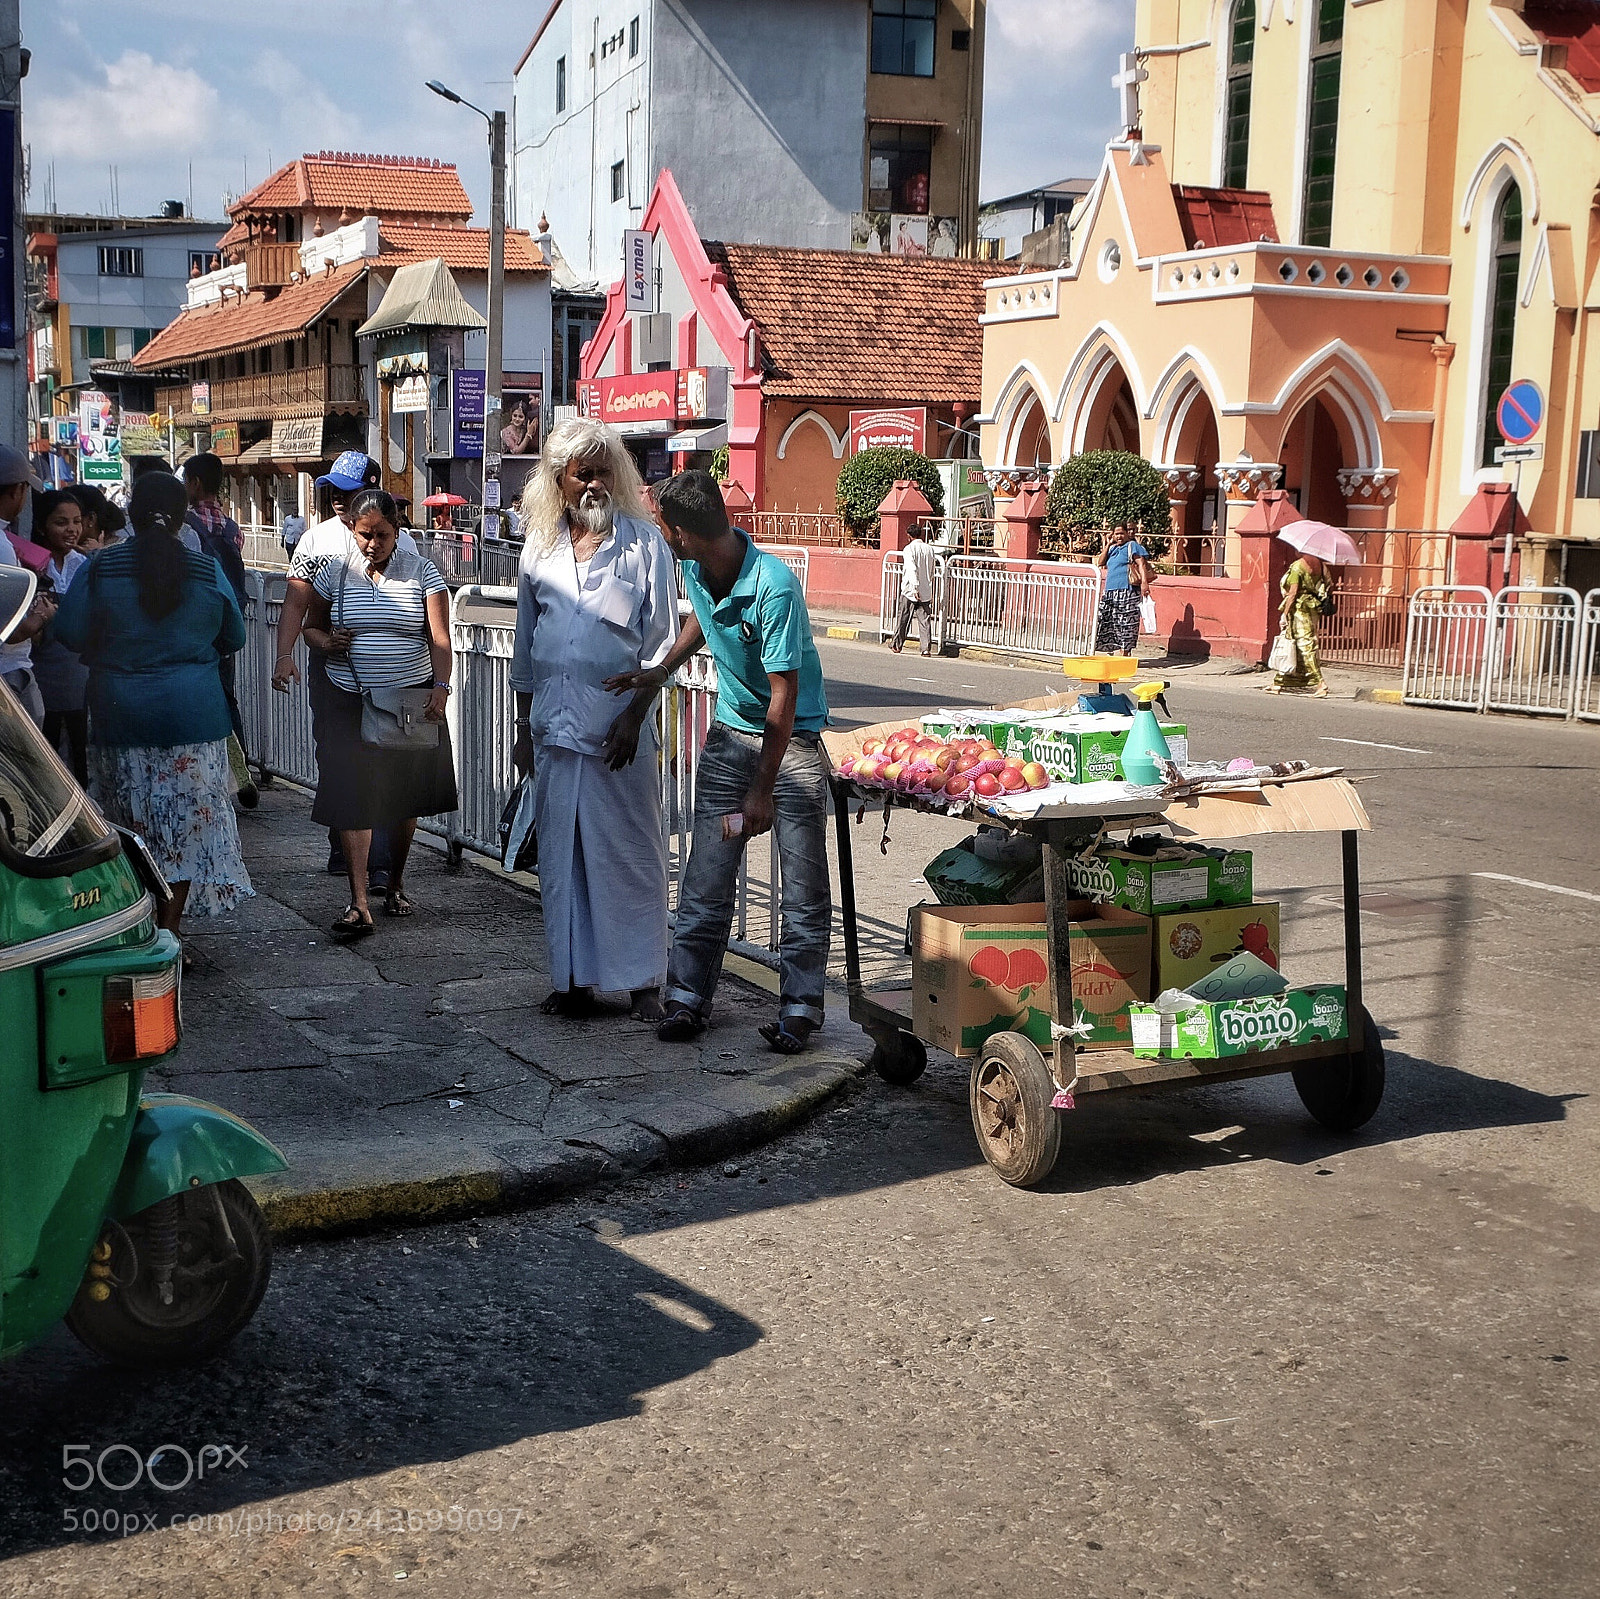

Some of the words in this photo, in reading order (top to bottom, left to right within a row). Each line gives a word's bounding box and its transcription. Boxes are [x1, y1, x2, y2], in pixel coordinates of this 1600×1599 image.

[630, 237, 649, 301] Laxman
[1034, 743, 1074, 773] bono
[1089, 763, 1116, 772] bono
[1224, 864, 1245, 876] bono
[1067, 864, 1113, 892] bono
[1127, 876, 1144, 887] bono
[1315, 1004, 1339, 1014] bono
[1188, 1017, 1206, 1025] bono
[1223, 1010, 1294, 1040] bono
